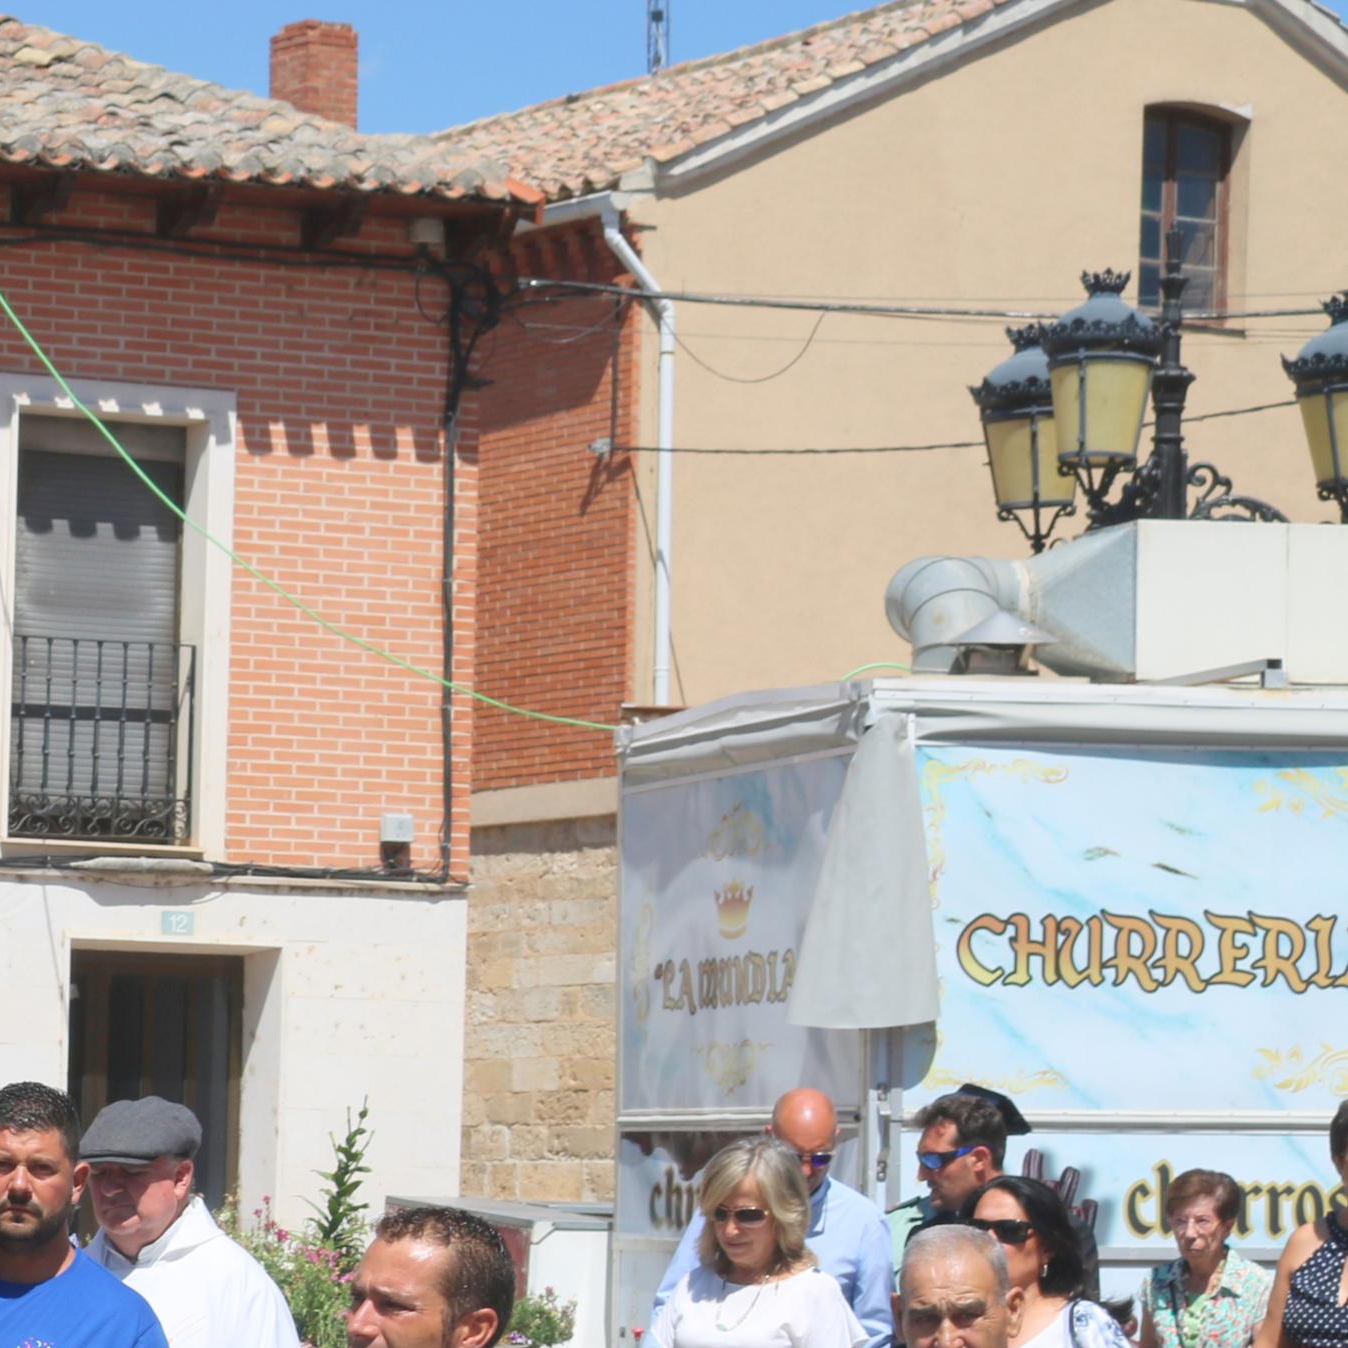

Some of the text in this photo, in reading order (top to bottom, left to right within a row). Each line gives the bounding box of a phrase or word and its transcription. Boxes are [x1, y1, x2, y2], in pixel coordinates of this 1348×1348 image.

[168, 914, 187, 933] 12
[956, 909, 1348, 994] CHURRERI
[698, 948, 796, 1010] MUNDIA
